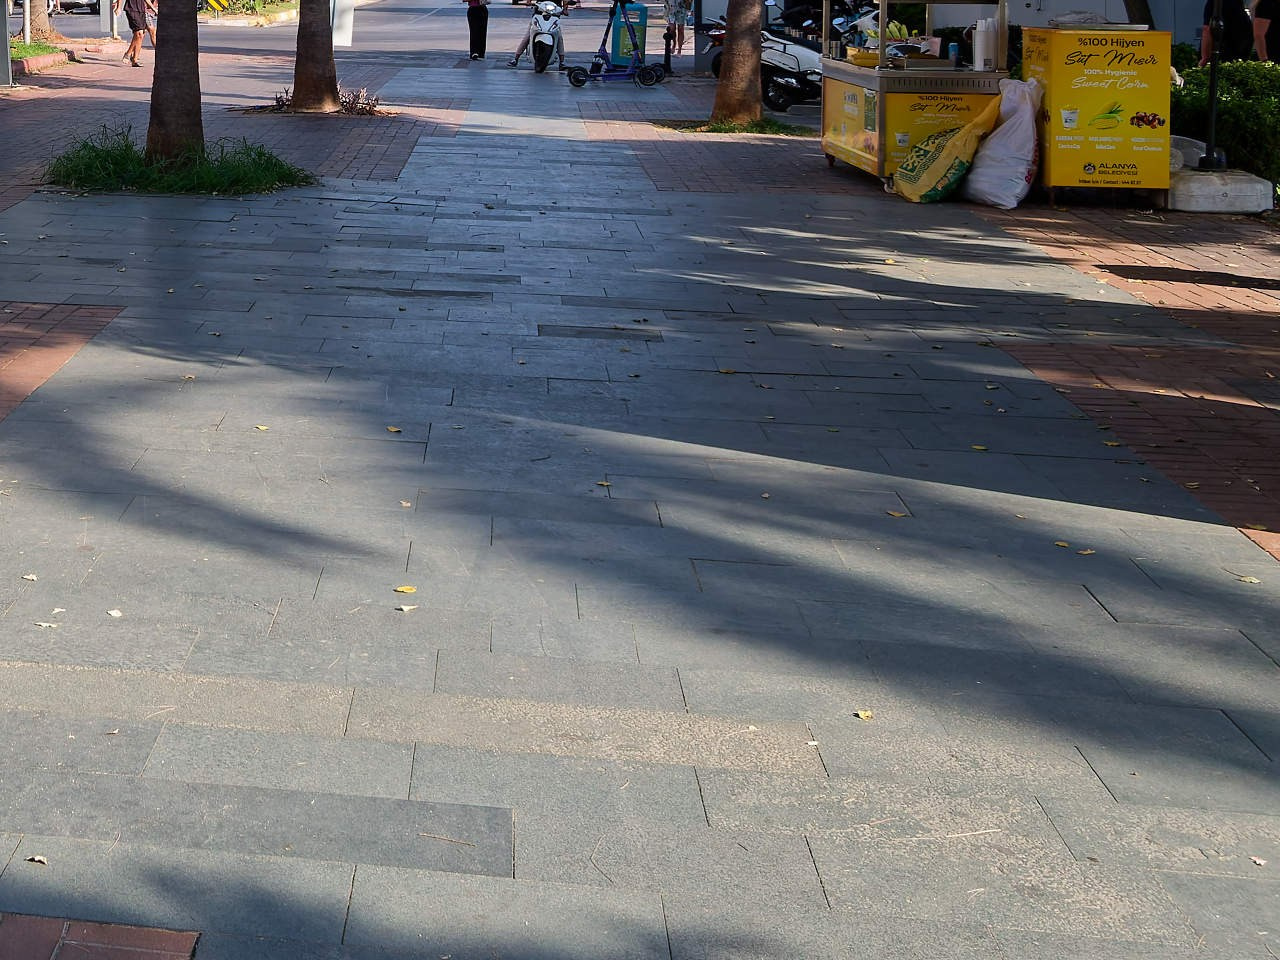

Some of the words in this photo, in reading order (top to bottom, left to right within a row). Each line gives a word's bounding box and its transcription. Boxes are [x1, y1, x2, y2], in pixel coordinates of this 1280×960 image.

[1078, 38, 1107, 47] %100
[1111, 38, 1145, 48] Hijyen
[1116, 77, 1149, 90] Corn
